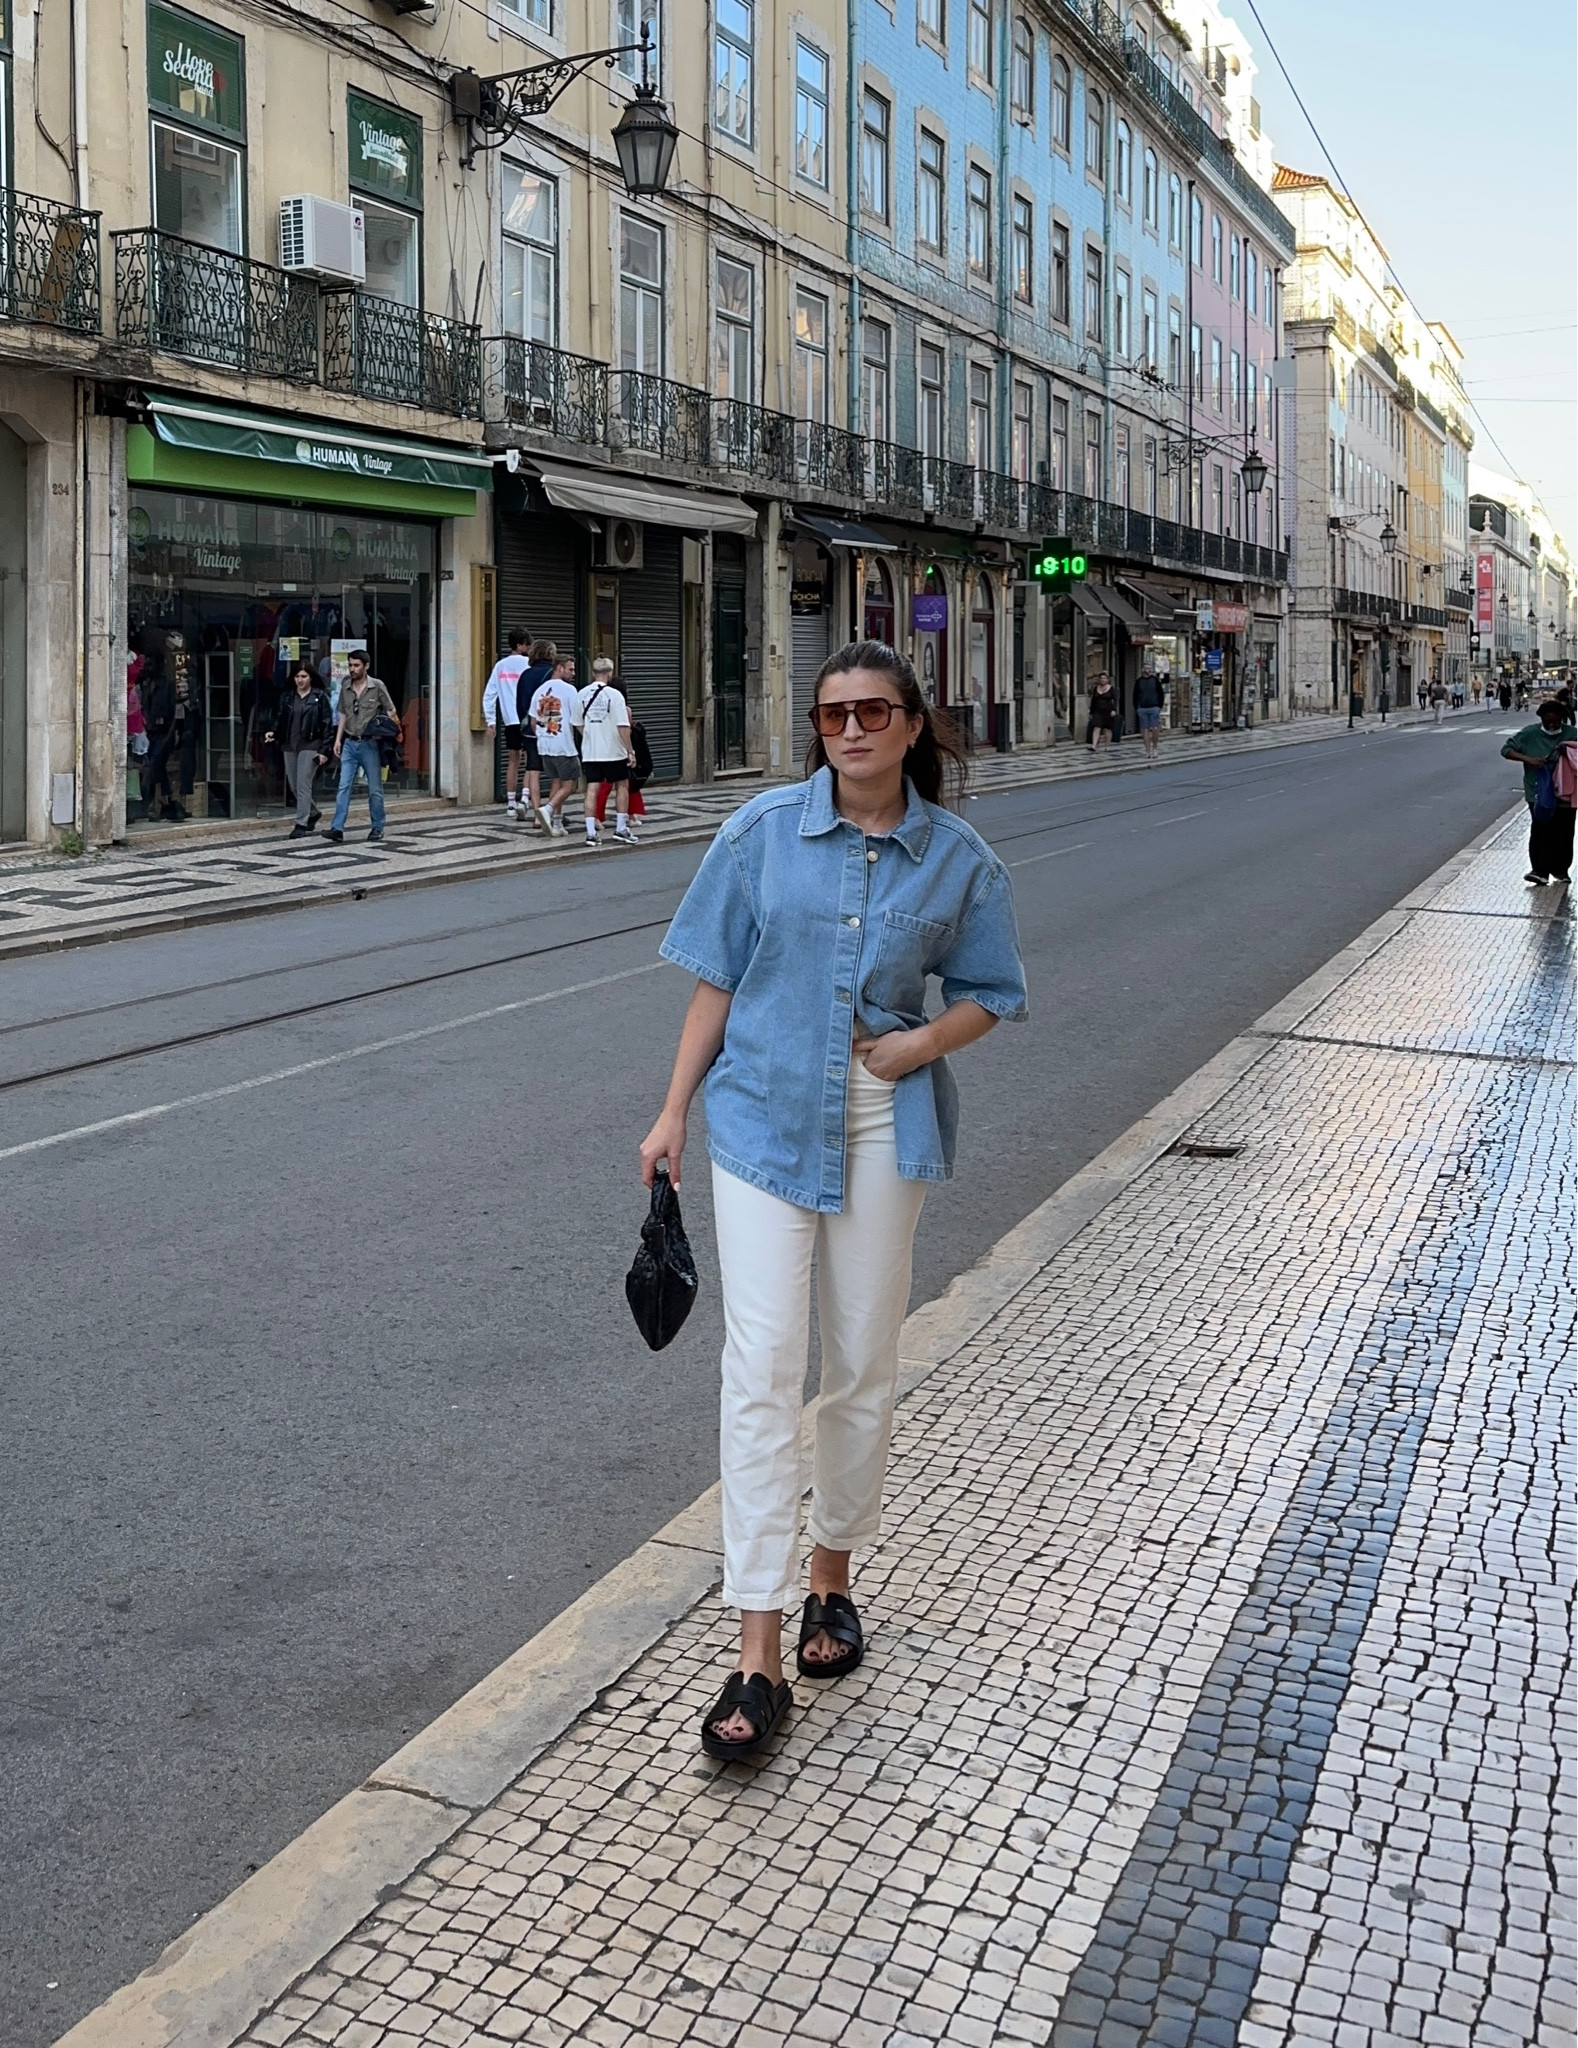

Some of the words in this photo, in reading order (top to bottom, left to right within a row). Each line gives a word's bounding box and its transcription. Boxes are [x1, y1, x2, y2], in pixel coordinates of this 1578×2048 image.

[163, 50, 214, 89] Second
[359, 121, 402, 155] Vintage
[312, 446, 360, 468] HUMANA
[362, 453, 393, 475] Vintage
[52, 482, 69, 496] 234
[158, 520, 240, 546] HUMANA
[193, 547, 242, 575] Vintage
[356, 539, 418, 560] HUMANA
[383, 562, 420, 586] Vintage
